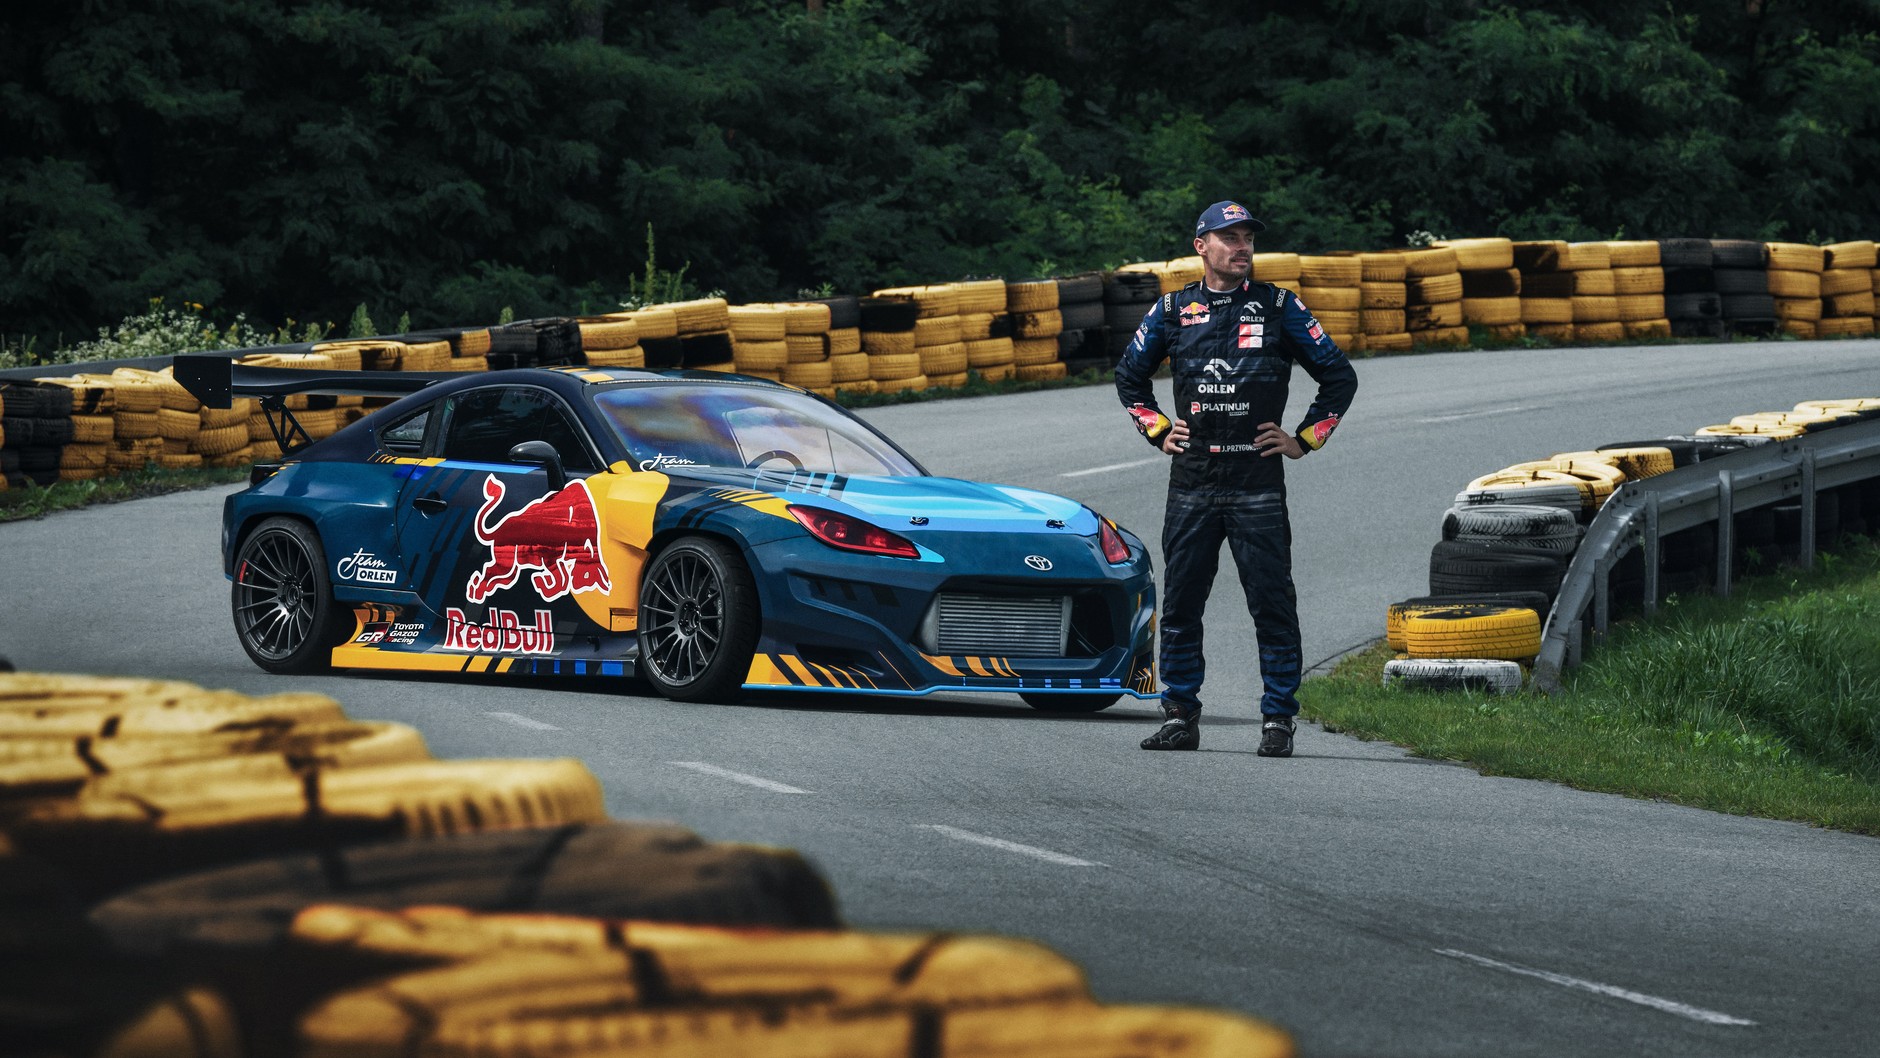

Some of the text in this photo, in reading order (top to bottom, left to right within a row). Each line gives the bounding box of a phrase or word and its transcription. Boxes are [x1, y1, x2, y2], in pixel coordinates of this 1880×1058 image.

[1198, 384, 1235, 394] ORLEN
[1202, 402, 1250, 411] PLATINUM
[360, 570, 394, 581] ORLEN
[356, 632, 384, 642] GR
[385, 636, 415, 645] Racing
